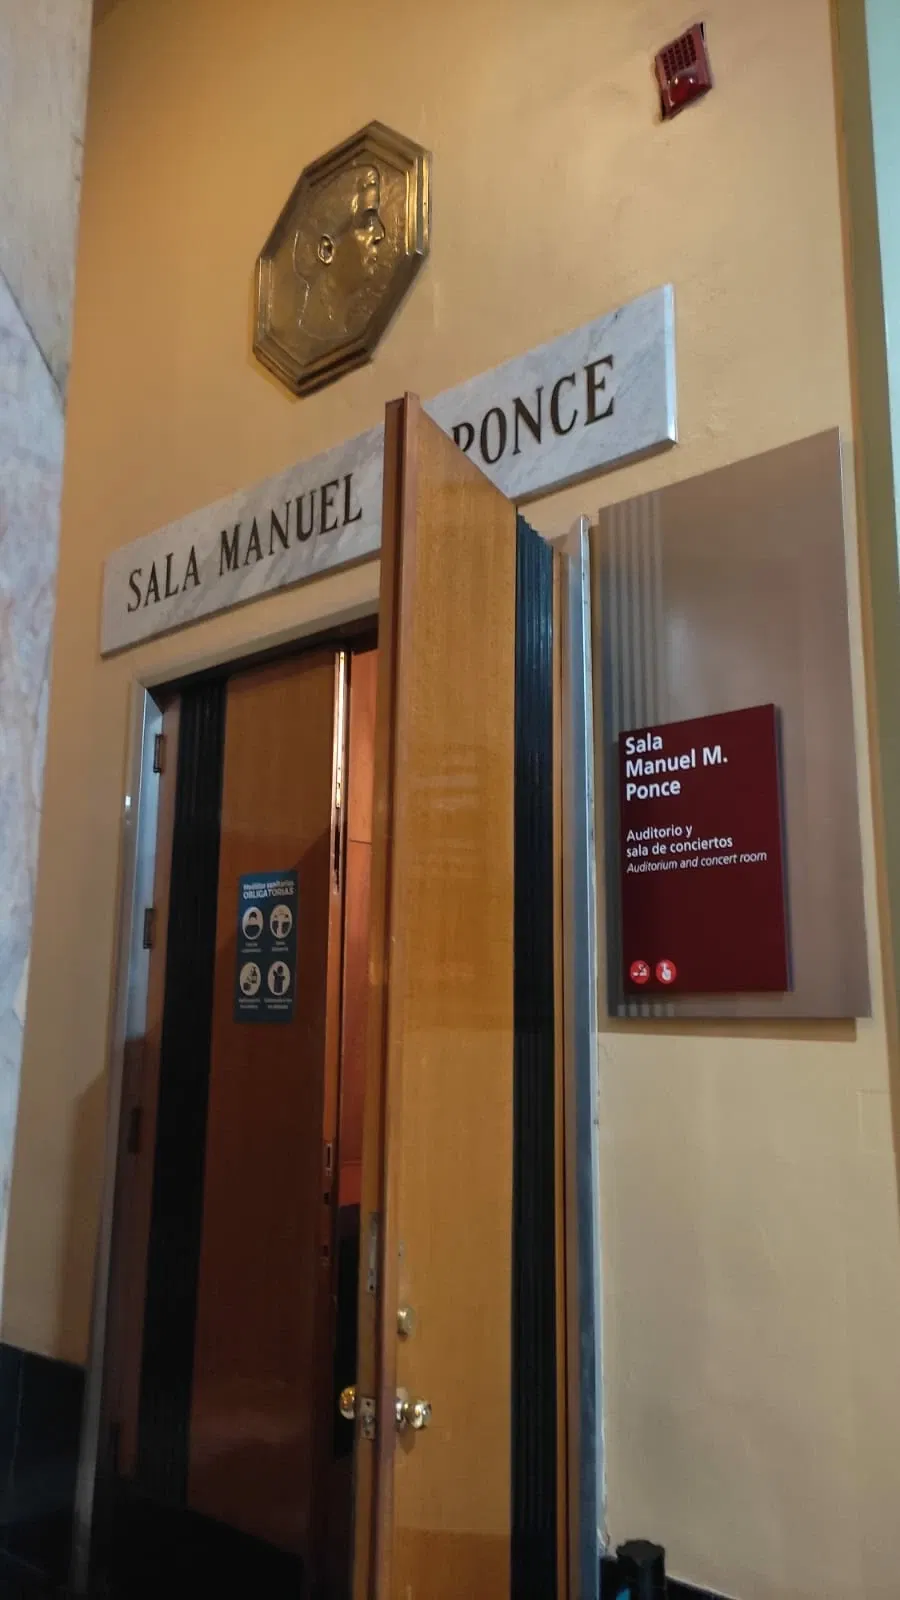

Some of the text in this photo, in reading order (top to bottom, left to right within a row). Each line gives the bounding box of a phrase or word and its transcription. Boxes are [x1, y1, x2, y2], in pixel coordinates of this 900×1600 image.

[127, 354, 615, 612] SALA MANUEL PONCE
[626, 733, 663, 755] Sala
[626, 745, 728, 778] Manuel M.
[626, 779, 682, 801] Ponce
[626, 824, 693, 842] Auditorio y
[626, 835, 734, 858] sala de conciertos
[626, 851, 768, 874] Auditorium and concert room
[243, 887, 294, 900] OBLIGATORIAS
